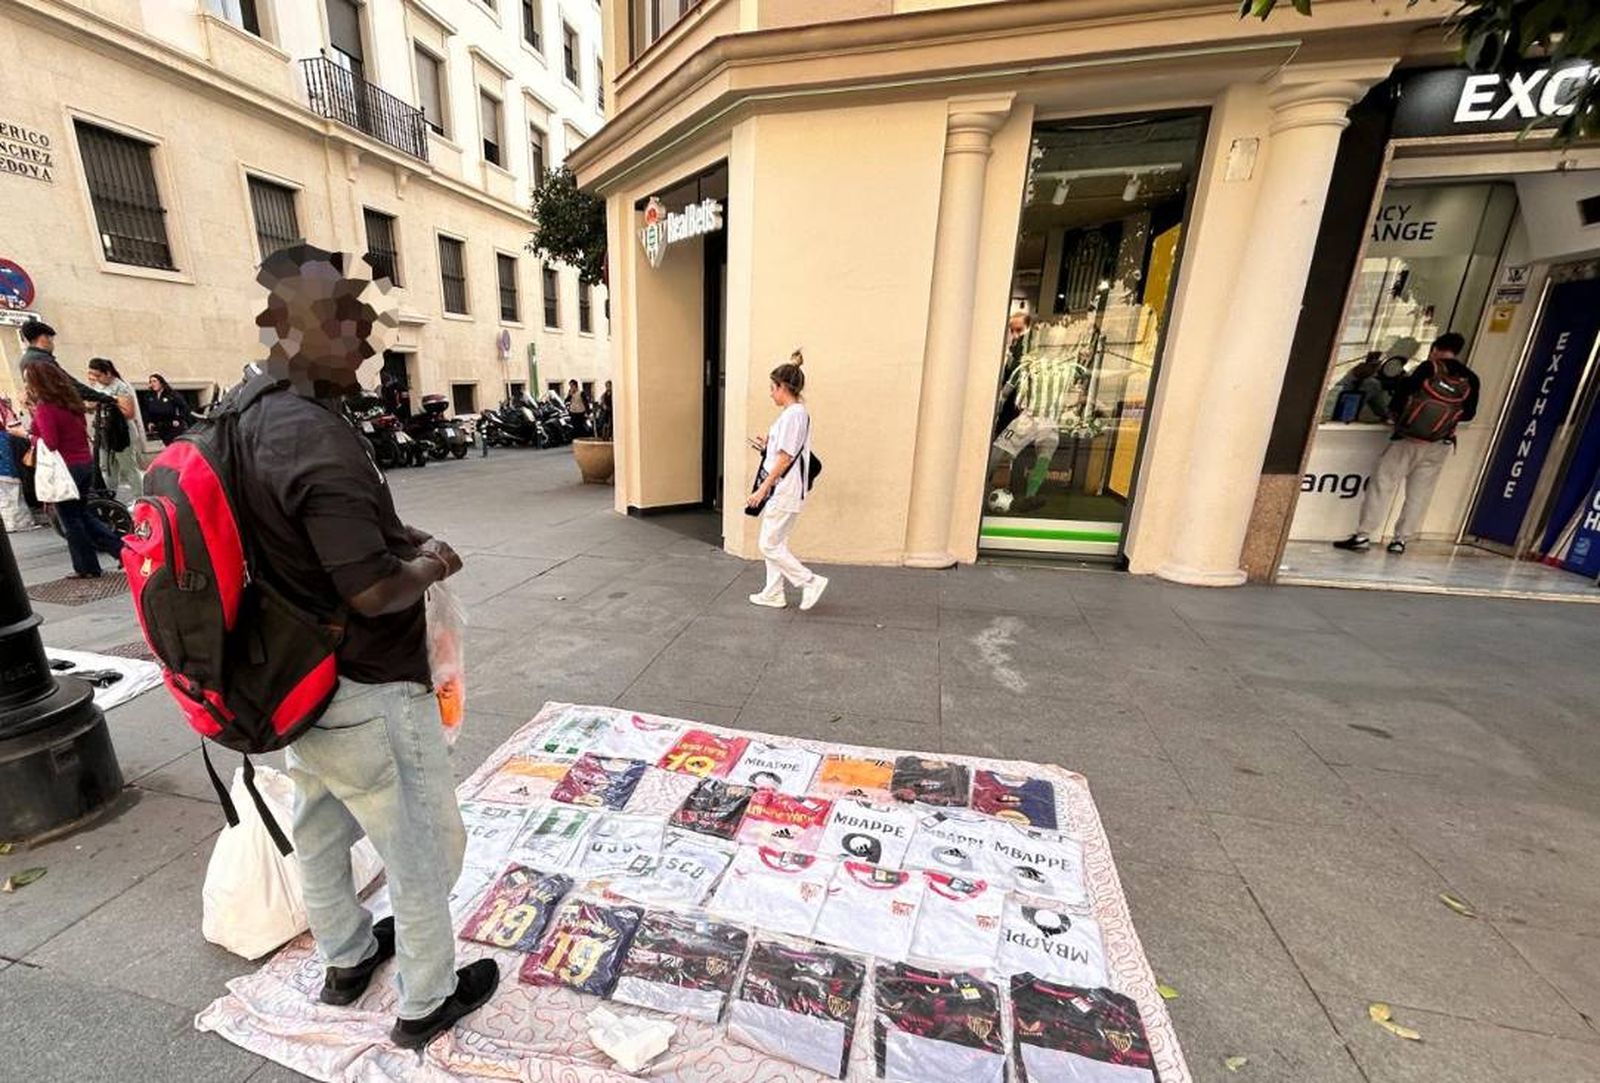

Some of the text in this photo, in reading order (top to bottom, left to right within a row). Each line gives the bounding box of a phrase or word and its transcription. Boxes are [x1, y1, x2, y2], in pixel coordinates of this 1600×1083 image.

[1503, 332, 1570, 498] EXCHANGE
[833, 811, 905, 839] MBAPPE
[994, 841, 1073, 872] MBAPPE
[545, 932, 602, 985] 19
